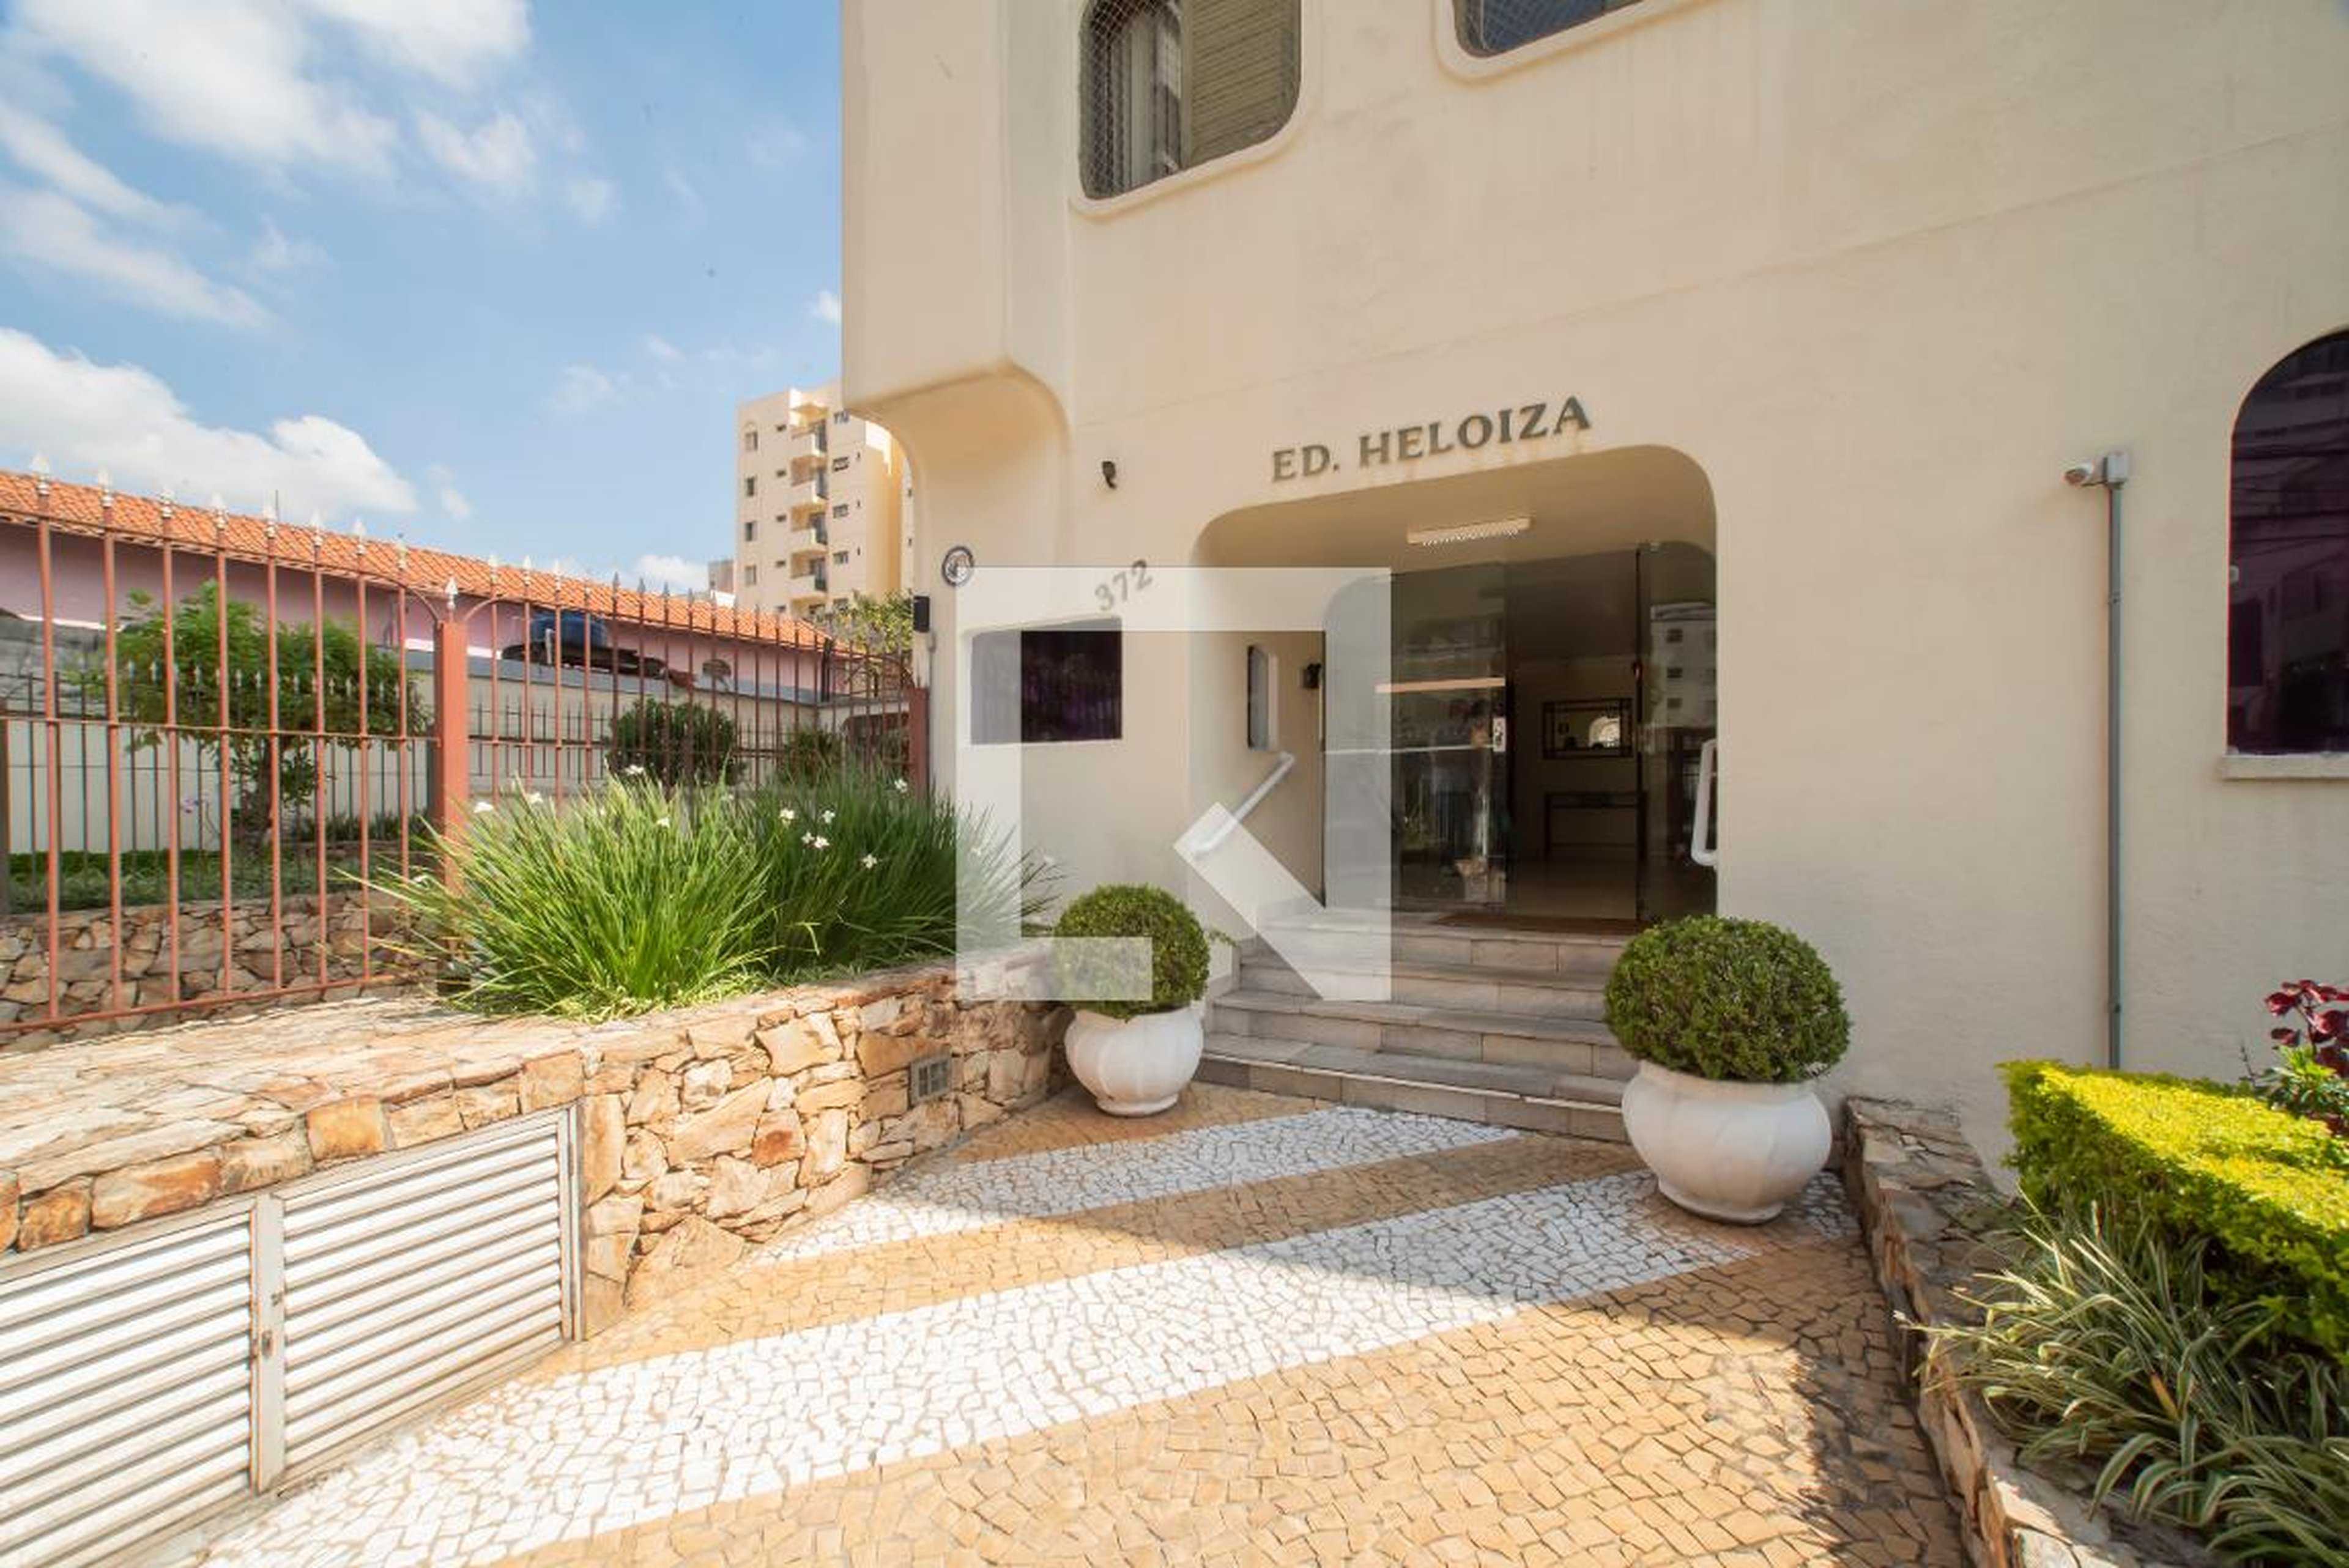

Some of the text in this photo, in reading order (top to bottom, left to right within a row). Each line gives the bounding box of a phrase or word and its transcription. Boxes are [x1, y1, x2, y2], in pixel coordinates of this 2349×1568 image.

[1272, 396, 1591, 482] ED. HELOIZA
[1095, 559, 1153, 611] 372
